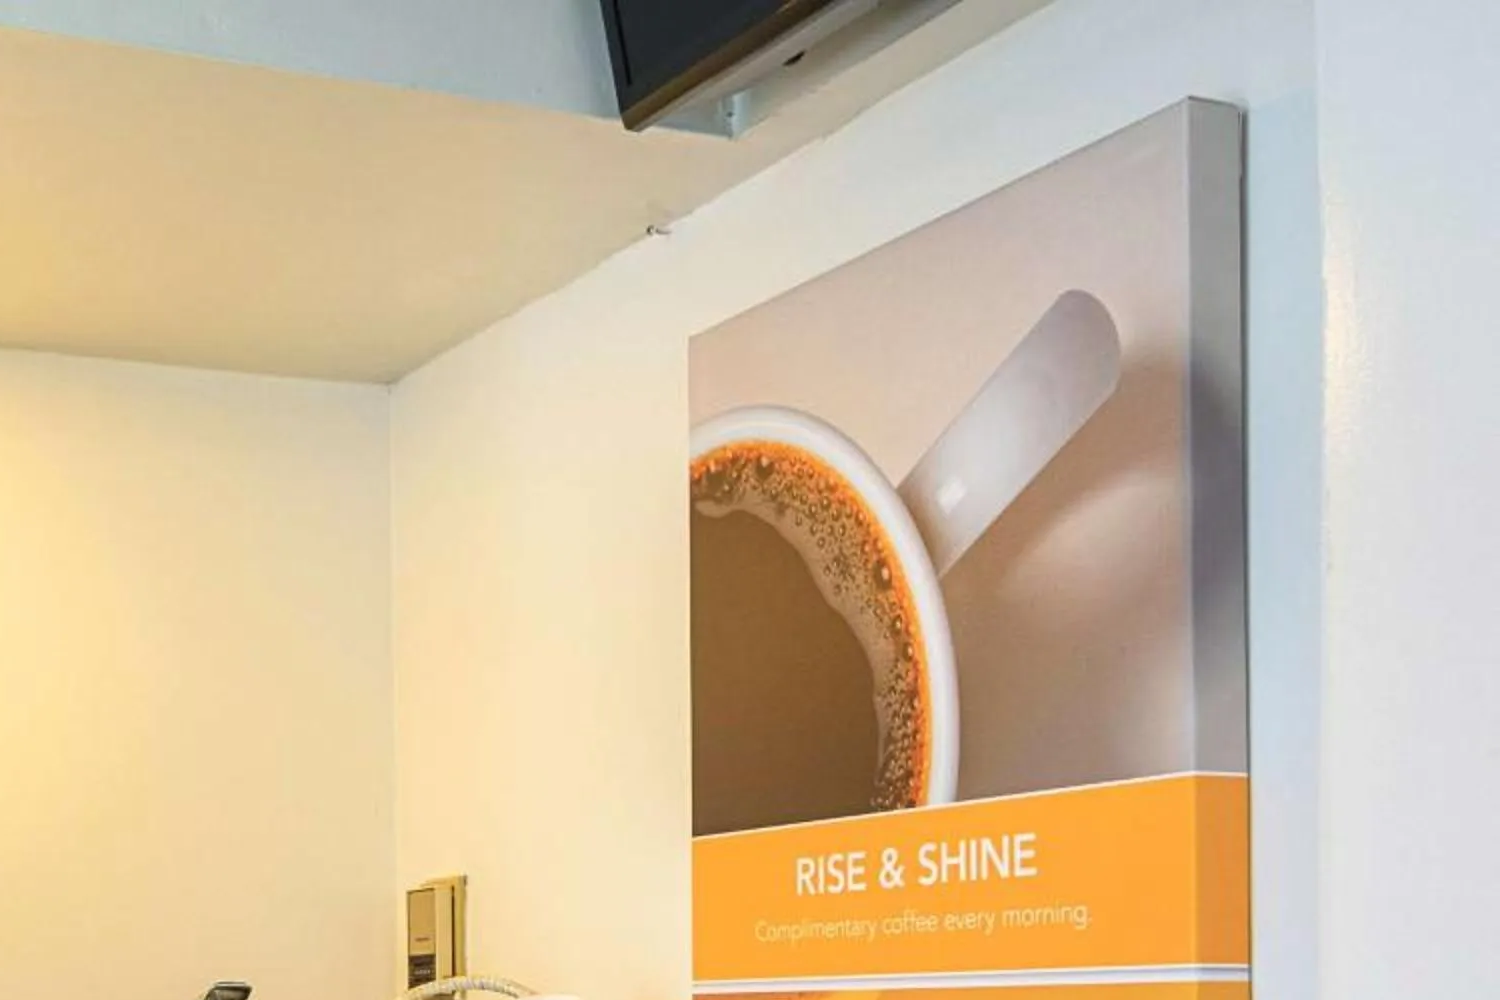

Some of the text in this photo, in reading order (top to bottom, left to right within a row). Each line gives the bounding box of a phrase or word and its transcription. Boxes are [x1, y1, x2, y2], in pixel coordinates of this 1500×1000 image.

[796, 832, 1037, 895] RISE & SHINE
[755, 902, 1093, 946] Complimentary coffee every morning.
